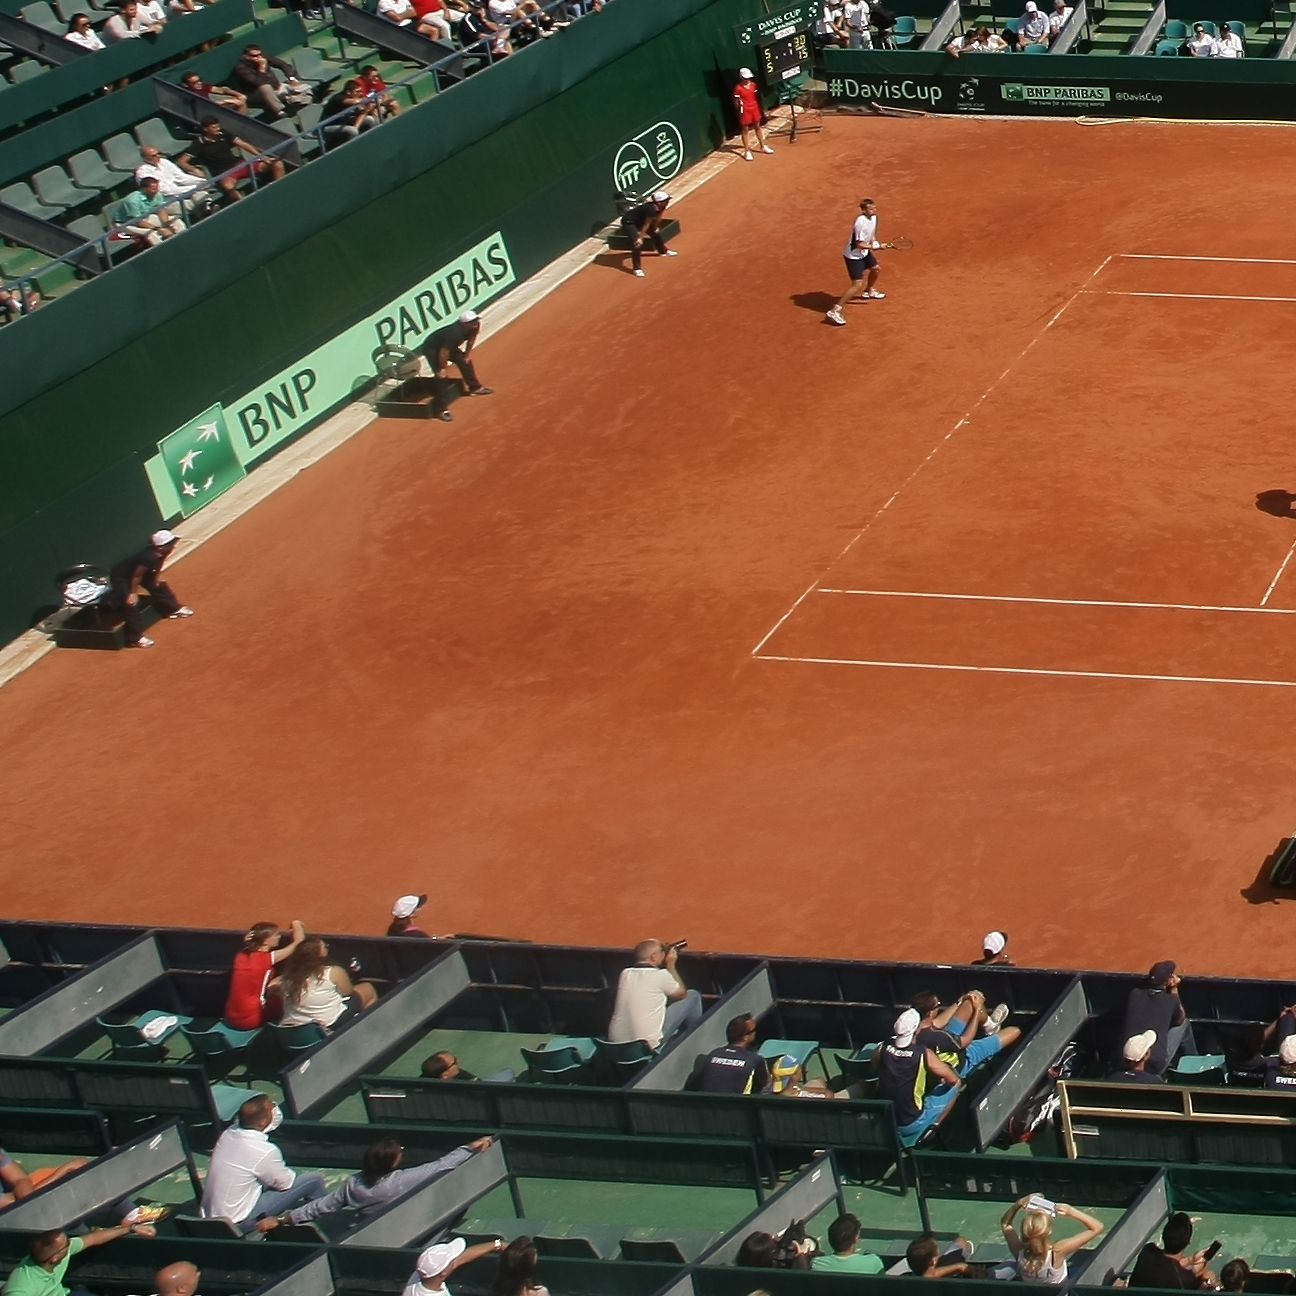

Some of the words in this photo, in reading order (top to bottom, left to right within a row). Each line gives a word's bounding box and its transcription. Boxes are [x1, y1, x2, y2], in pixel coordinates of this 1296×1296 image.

[783, 8, 802, 21] CUP
[828, 78, 943, 105] #DavisCup
[1027, 87, 1051, 98] BNP
[1054, 88, 1104, 99] PARIBAS
[1115, 93, 1163, 103] @DavisCup
[619, 164, 640, 189] ITF
[237, 368, 317, 449] BNP
[374, 242, 509, 347] PARIBAS
[711, 1057, 746, 1068] SWEDEN
